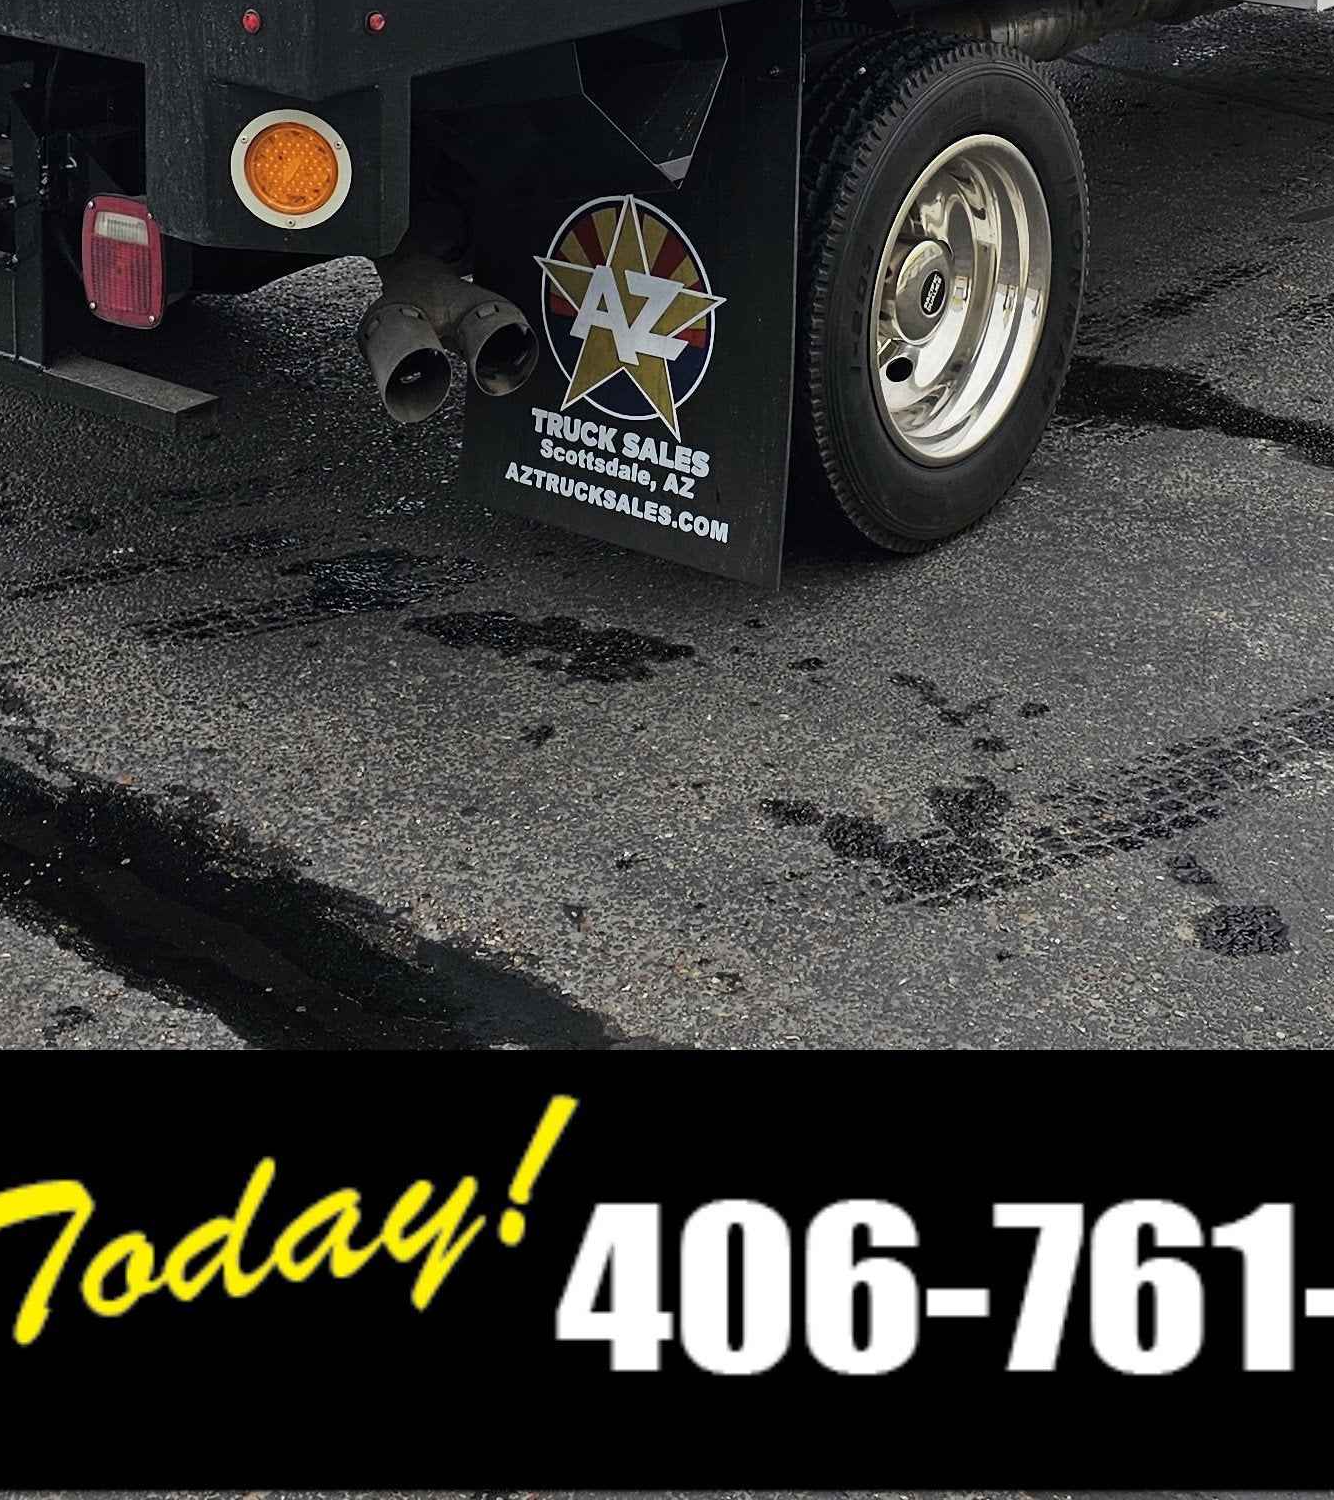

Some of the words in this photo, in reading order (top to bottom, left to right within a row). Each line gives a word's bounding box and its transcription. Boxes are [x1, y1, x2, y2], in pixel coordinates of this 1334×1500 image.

[570, 264, 689, 366] AZ
[531, 406, 618, 454] TRUCK
[621, 432, 711, 478] SALES
[539, 438, 658, 493] Scottsdale,
[662, 472, 696, 500] AZ
[504, 461, 730, 544] AZTRUCKSALES.COM
